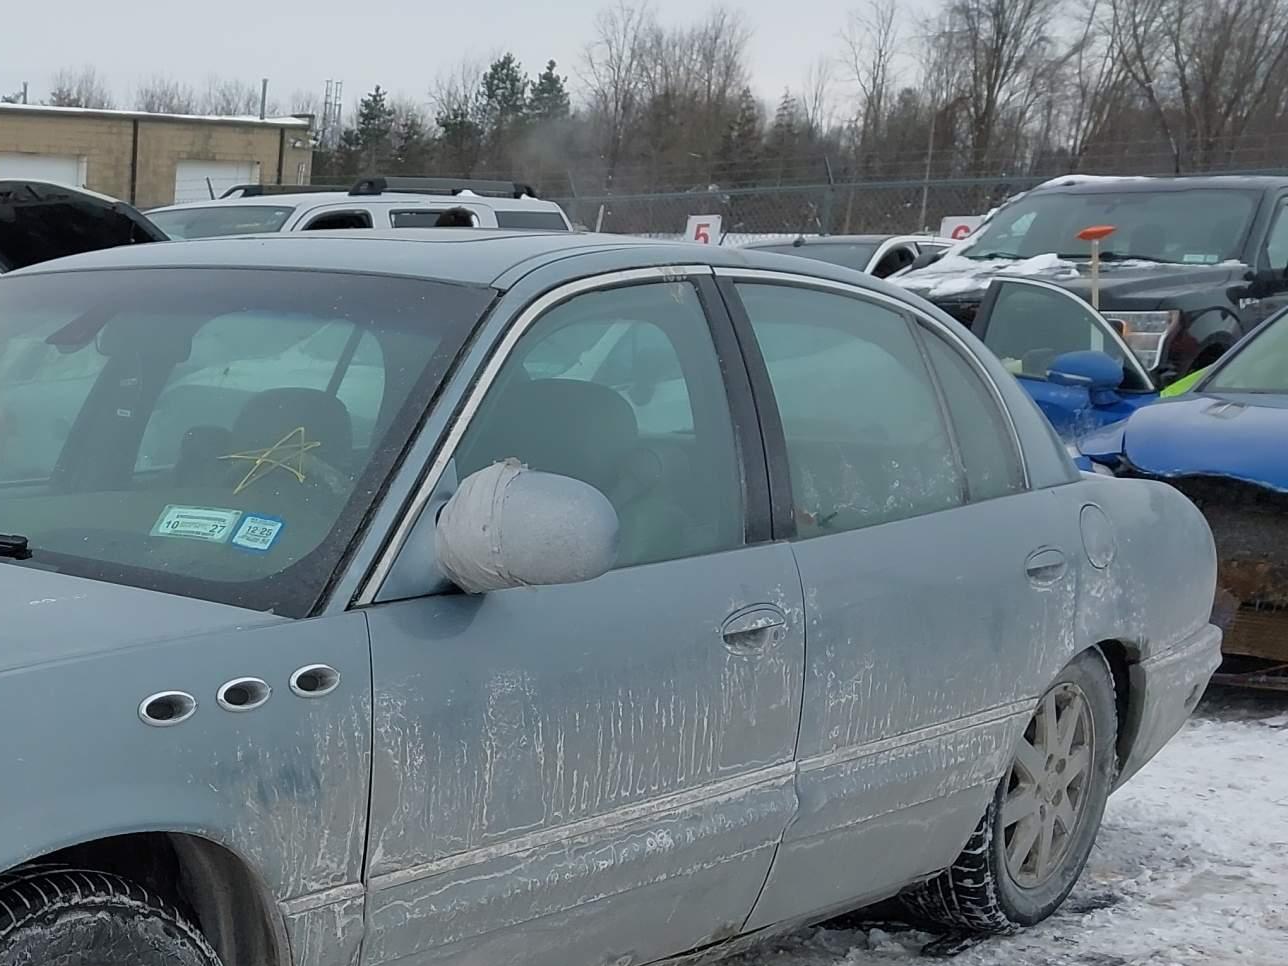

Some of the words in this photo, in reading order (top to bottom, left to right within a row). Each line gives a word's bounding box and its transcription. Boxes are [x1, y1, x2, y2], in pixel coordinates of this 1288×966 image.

[694, 223, 710, 245] 5
[165, 520, 180, 530] 10
[209, 524, 226, 534] 27
